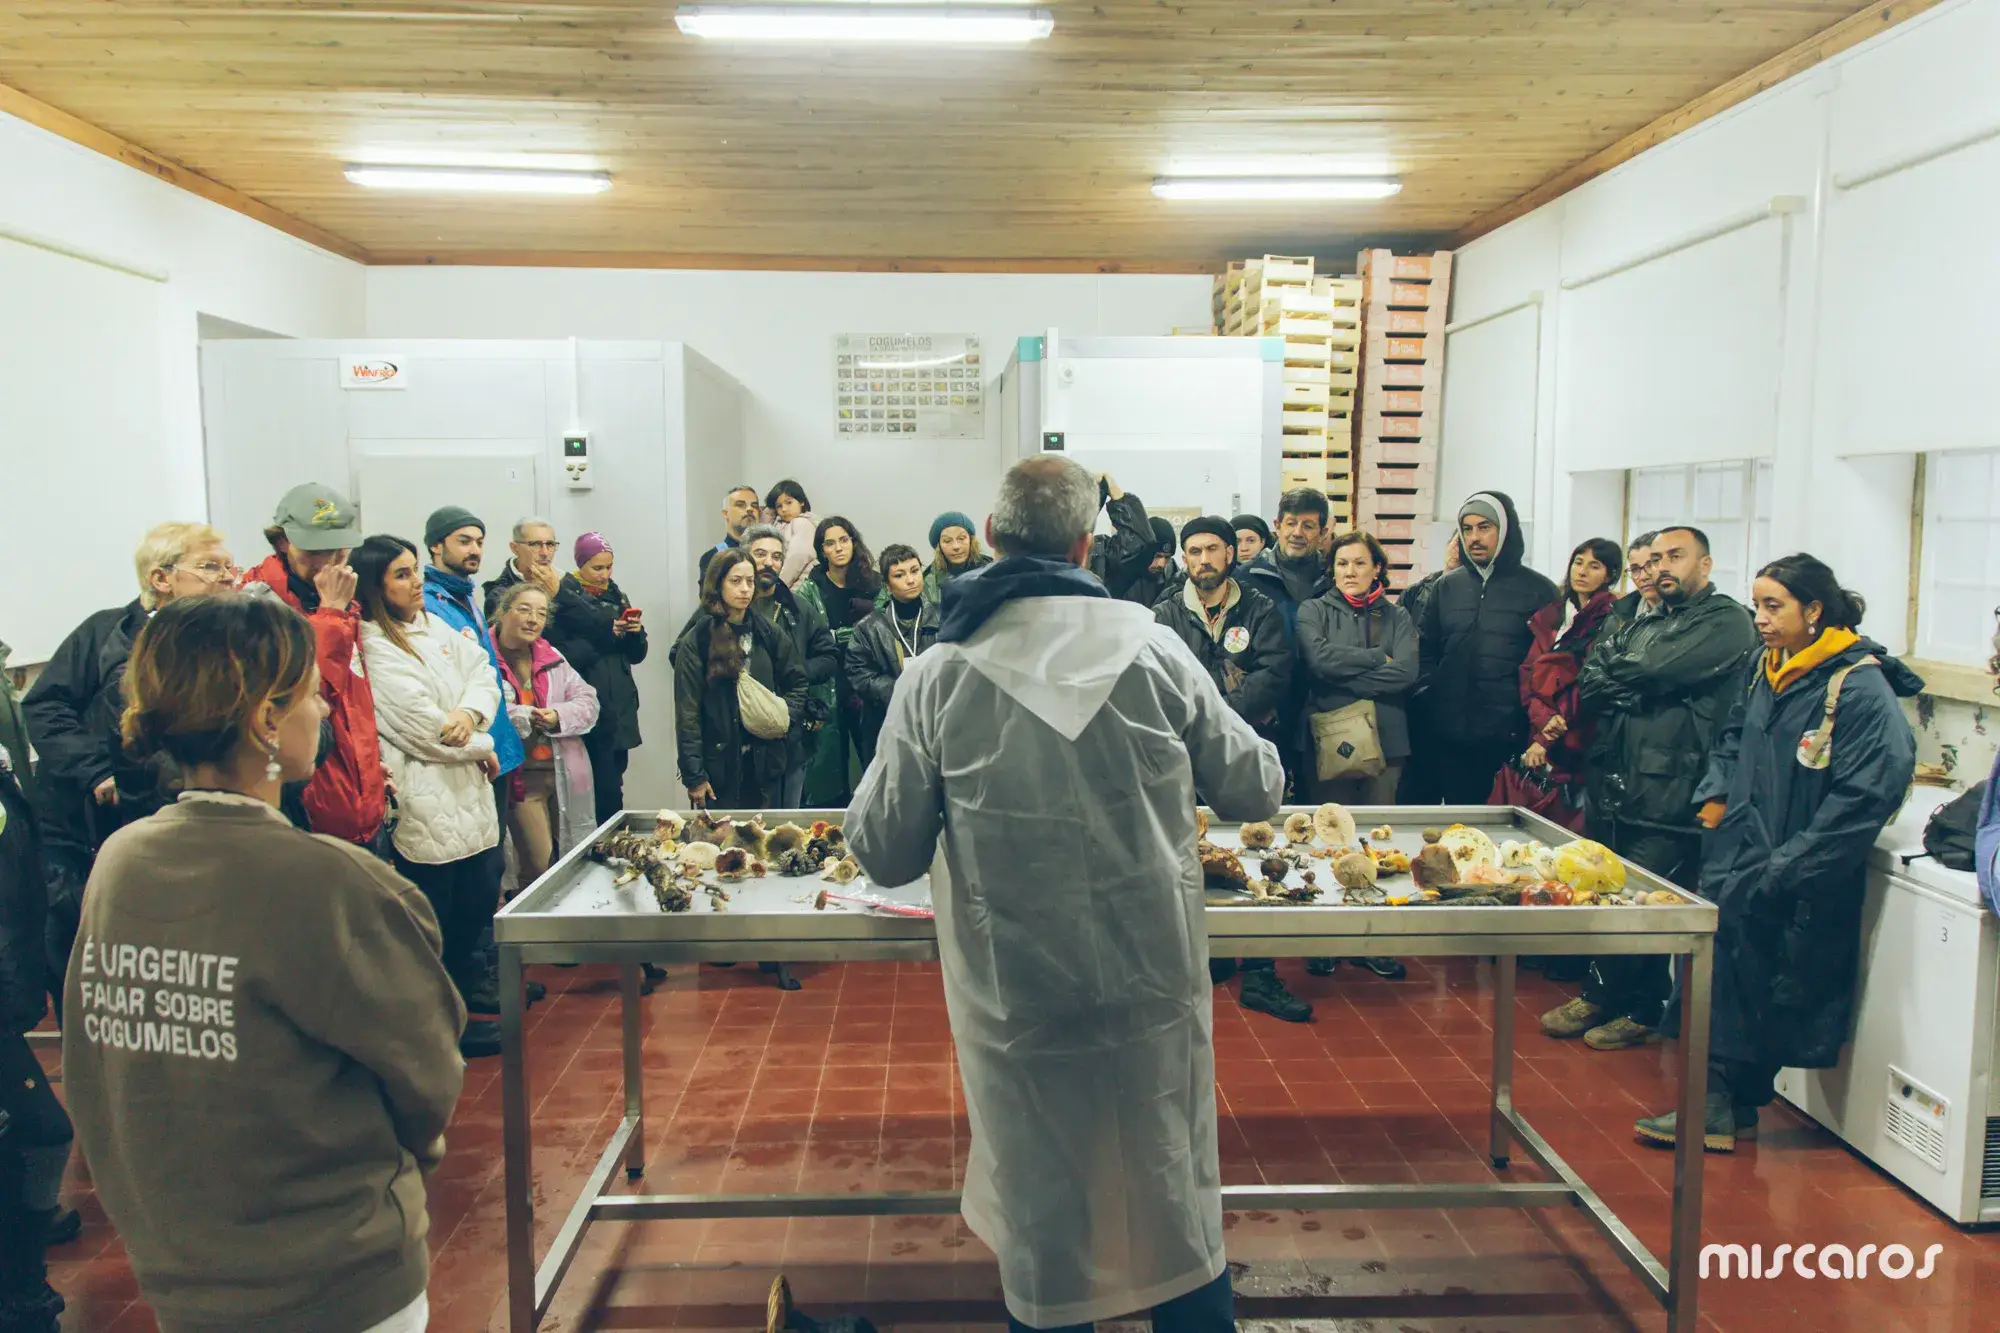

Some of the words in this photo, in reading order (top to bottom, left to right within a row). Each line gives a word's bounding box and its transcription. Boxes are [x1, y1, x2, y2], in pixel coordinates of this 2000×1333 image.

[869, 336, 932, 346] COGUMELOS
[1941, 926, 1948, 942] 3
[81, 934, 96, 974] É
[100, 942, 240, 993] URGENTE
[80, 981, 146, 1017] FALAR
[154, 988, 235, 1028] SOBRE
[84, 1013, 238, 1062] COGUMELOS
